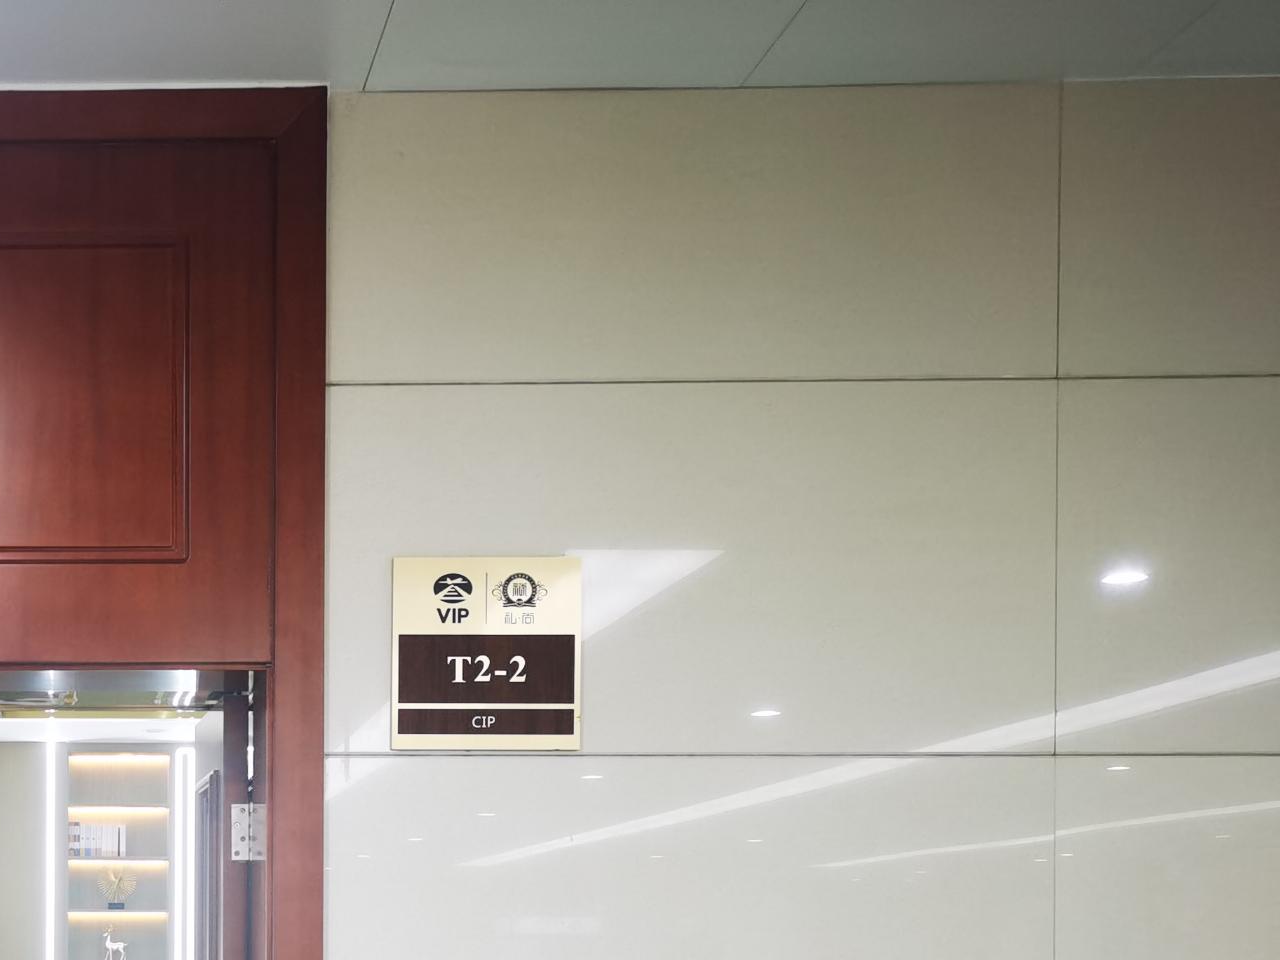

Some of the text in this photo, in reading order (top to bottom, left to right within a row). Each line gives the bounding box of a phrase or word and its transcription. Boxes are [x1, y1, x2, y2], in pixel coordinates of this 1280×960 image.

[437, 608, 469, 624] VIP
[447, 655, 527, 683] T2-2
[472, 716, 496, 728] CIP
